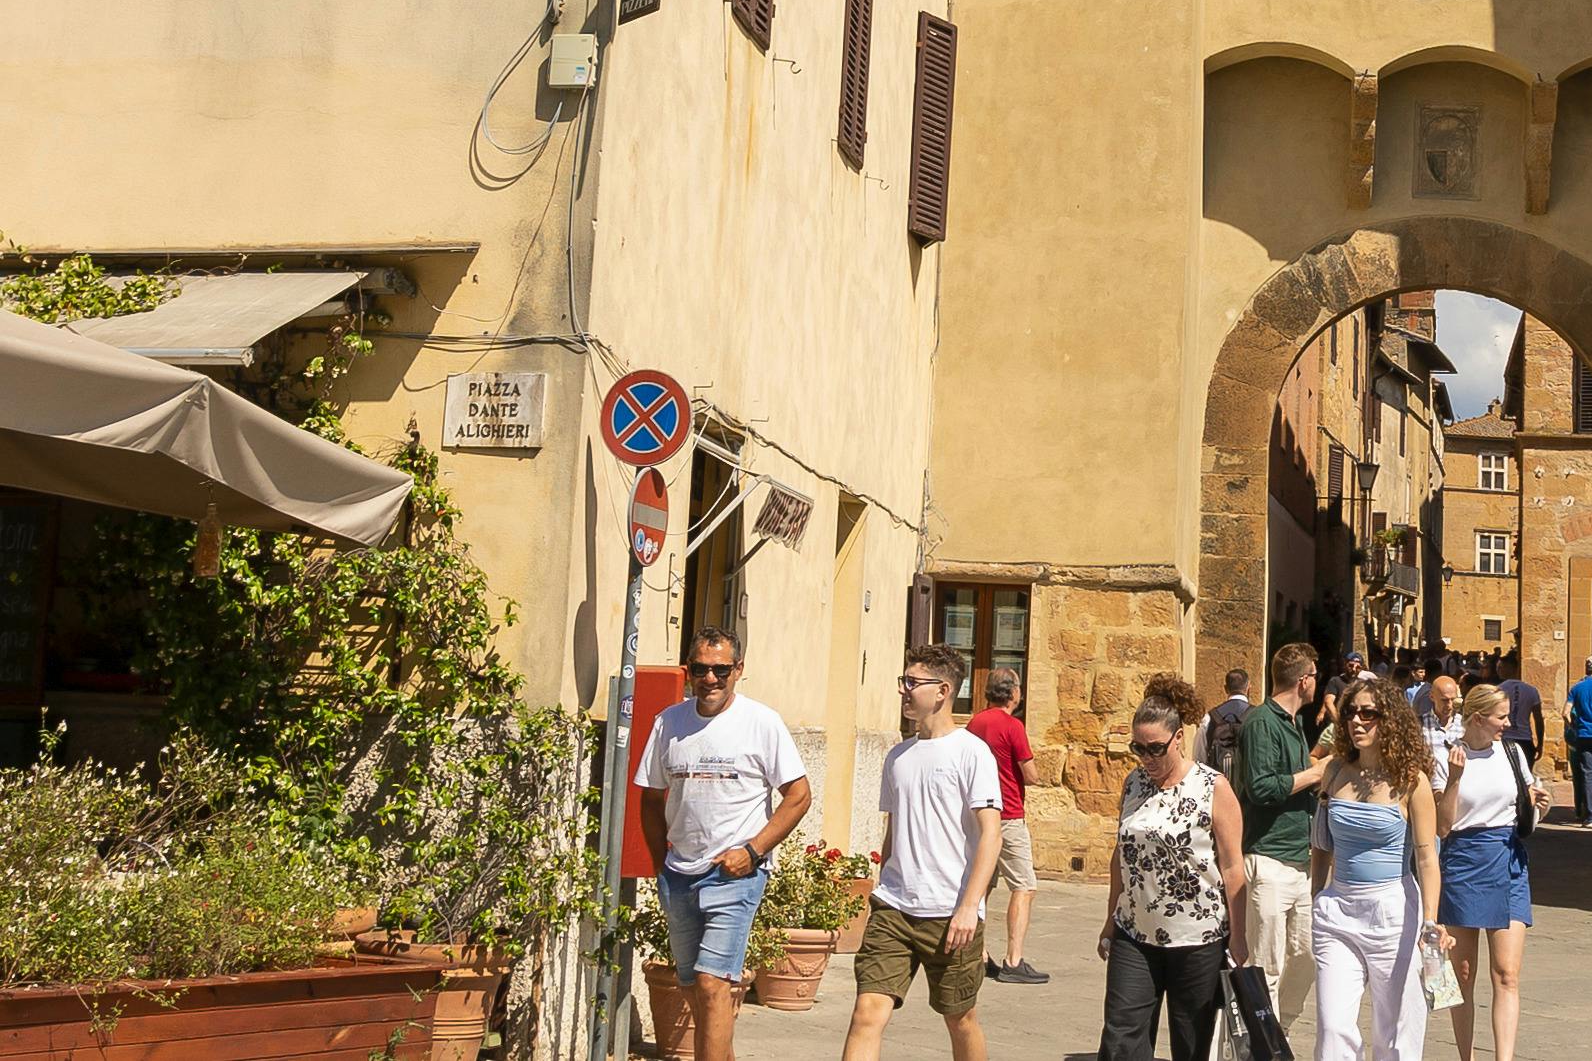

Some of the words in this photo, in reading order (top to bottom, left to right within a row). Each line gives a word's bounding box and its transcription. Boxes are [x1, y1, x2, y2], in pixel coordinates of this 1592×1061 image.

[468, 382, 521, 397] PIAZZA
[468, 403, 519, 418] DANTE
[455, 424, 530, 438] ALIGHIERI
